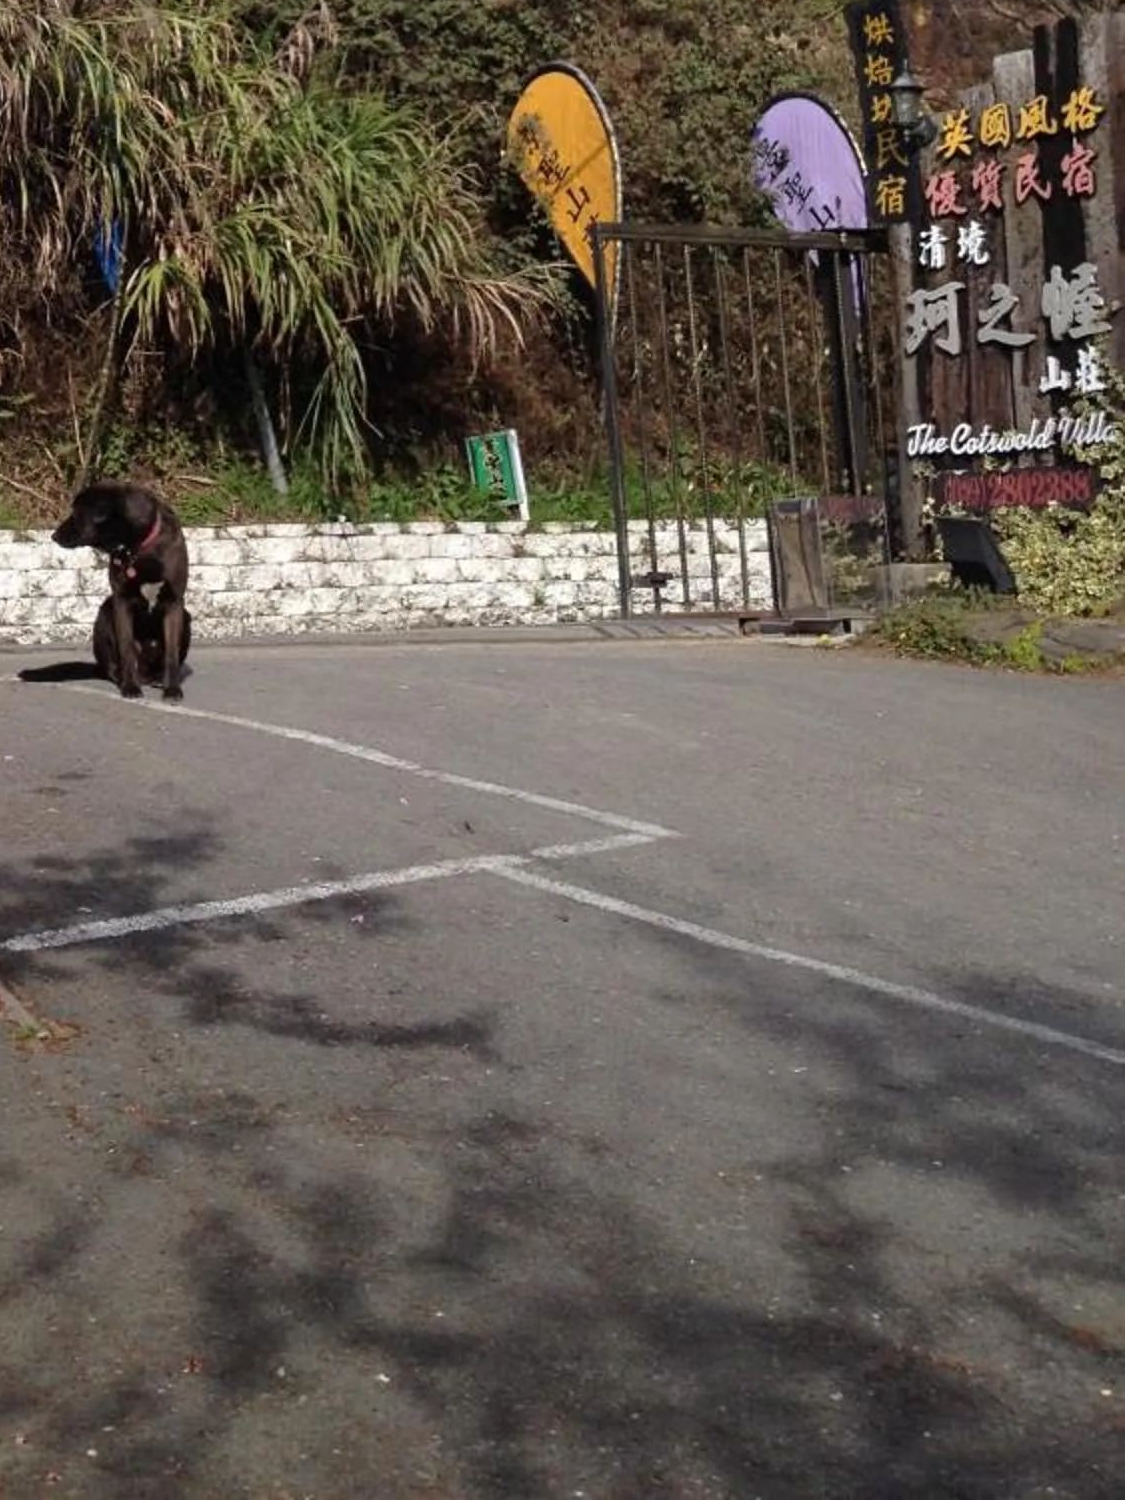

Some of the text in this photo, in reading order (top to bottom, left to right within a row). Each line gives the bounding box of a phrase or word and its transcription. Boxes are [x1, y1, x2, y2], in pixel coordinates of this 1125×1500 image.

[936, 86, 1105, 159] 英國風格
[925, 137, 1097, 217] 優質民宿
[918, 220, 990, 270] 清境
[906, 411, 1117, 456] The Cotswold Villa
